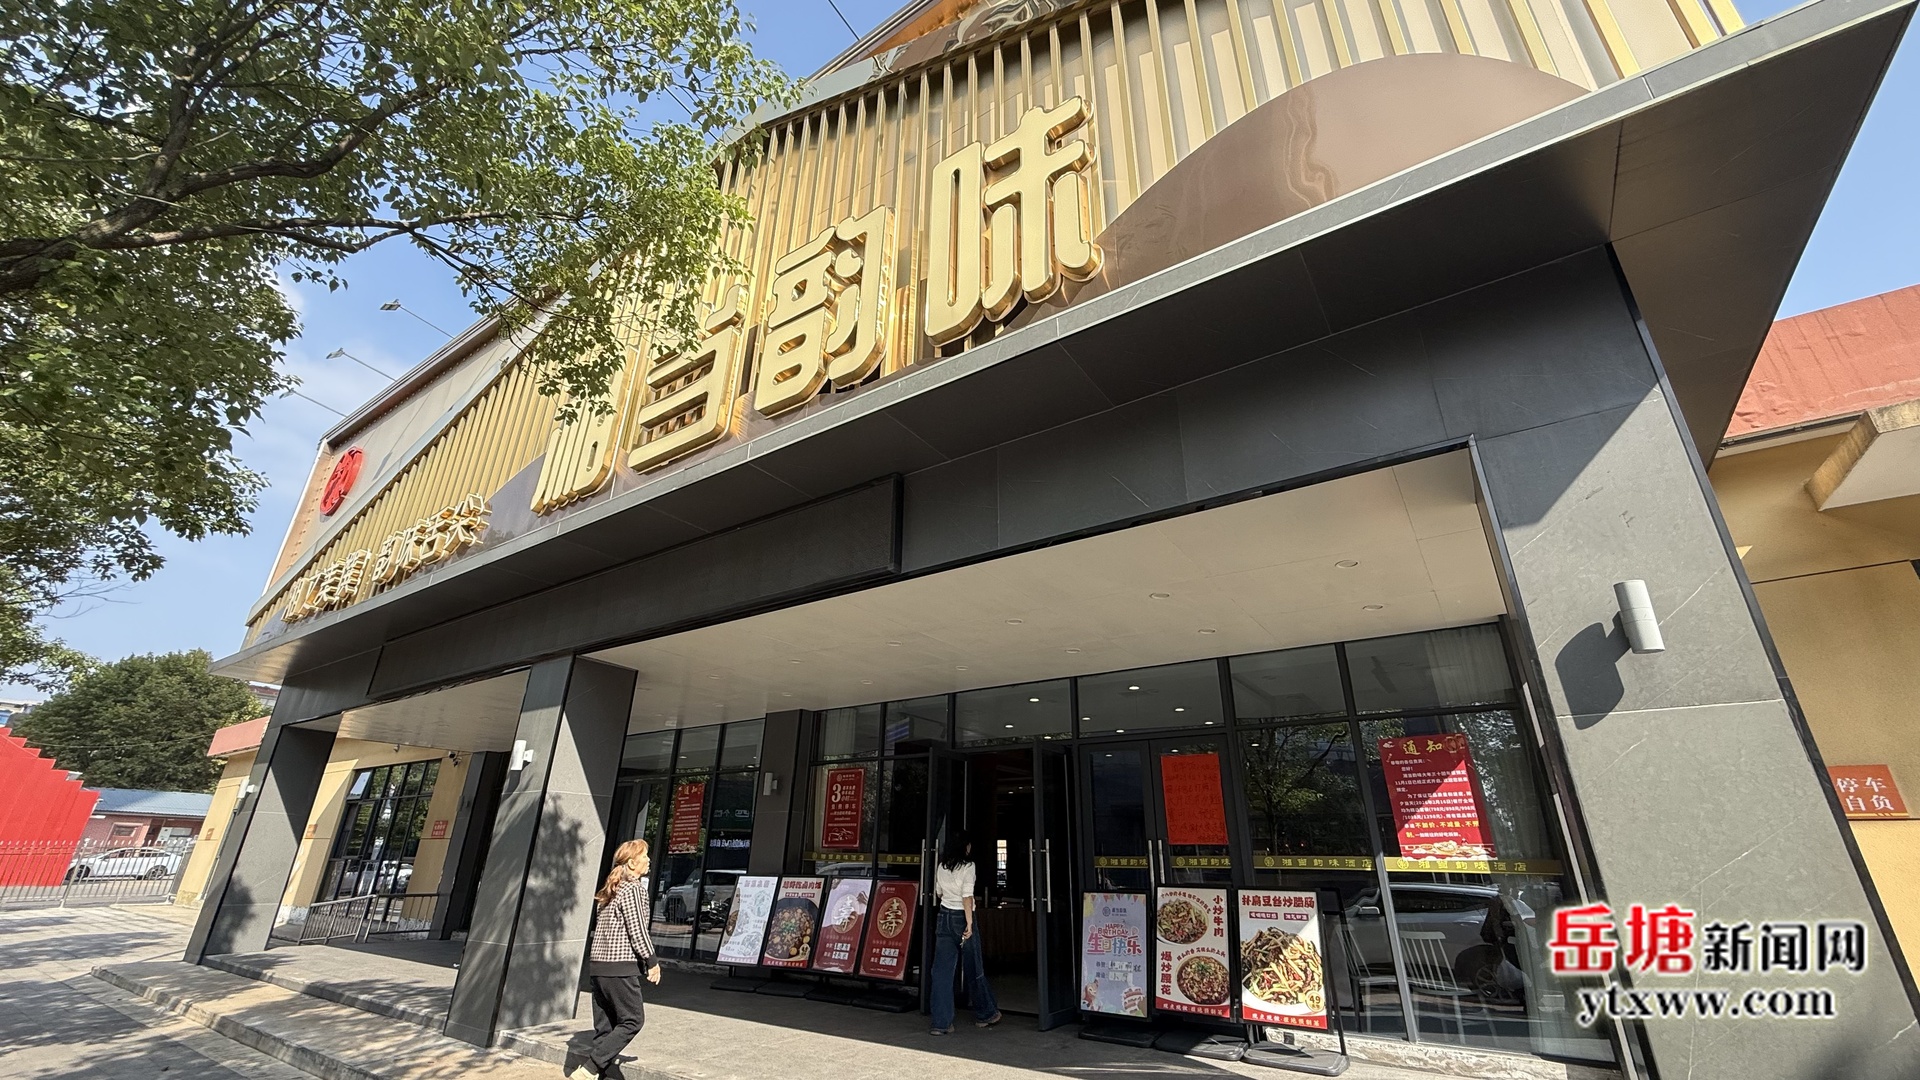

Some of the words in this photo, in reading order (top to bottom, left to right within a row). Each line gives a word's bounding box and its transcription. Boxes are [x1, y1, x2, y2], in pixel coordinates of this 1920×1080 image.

[1403, 740, 1443, 756] 通知
[831, 783, 842, 803] 3
[1836, 777, 1887, 793] 停车
[1845, 794, 1894, 811] 自负
[1212, 894, 1224, 938] 小炒牛肉
[1098, 927, 1129, 936] BIRTHDAY
[1087, 932, 1143, 956] 生日快乐
[1160, 950, 1173, 996] 爆炒腰花
[1309, 995, 1321, 1004] 49
